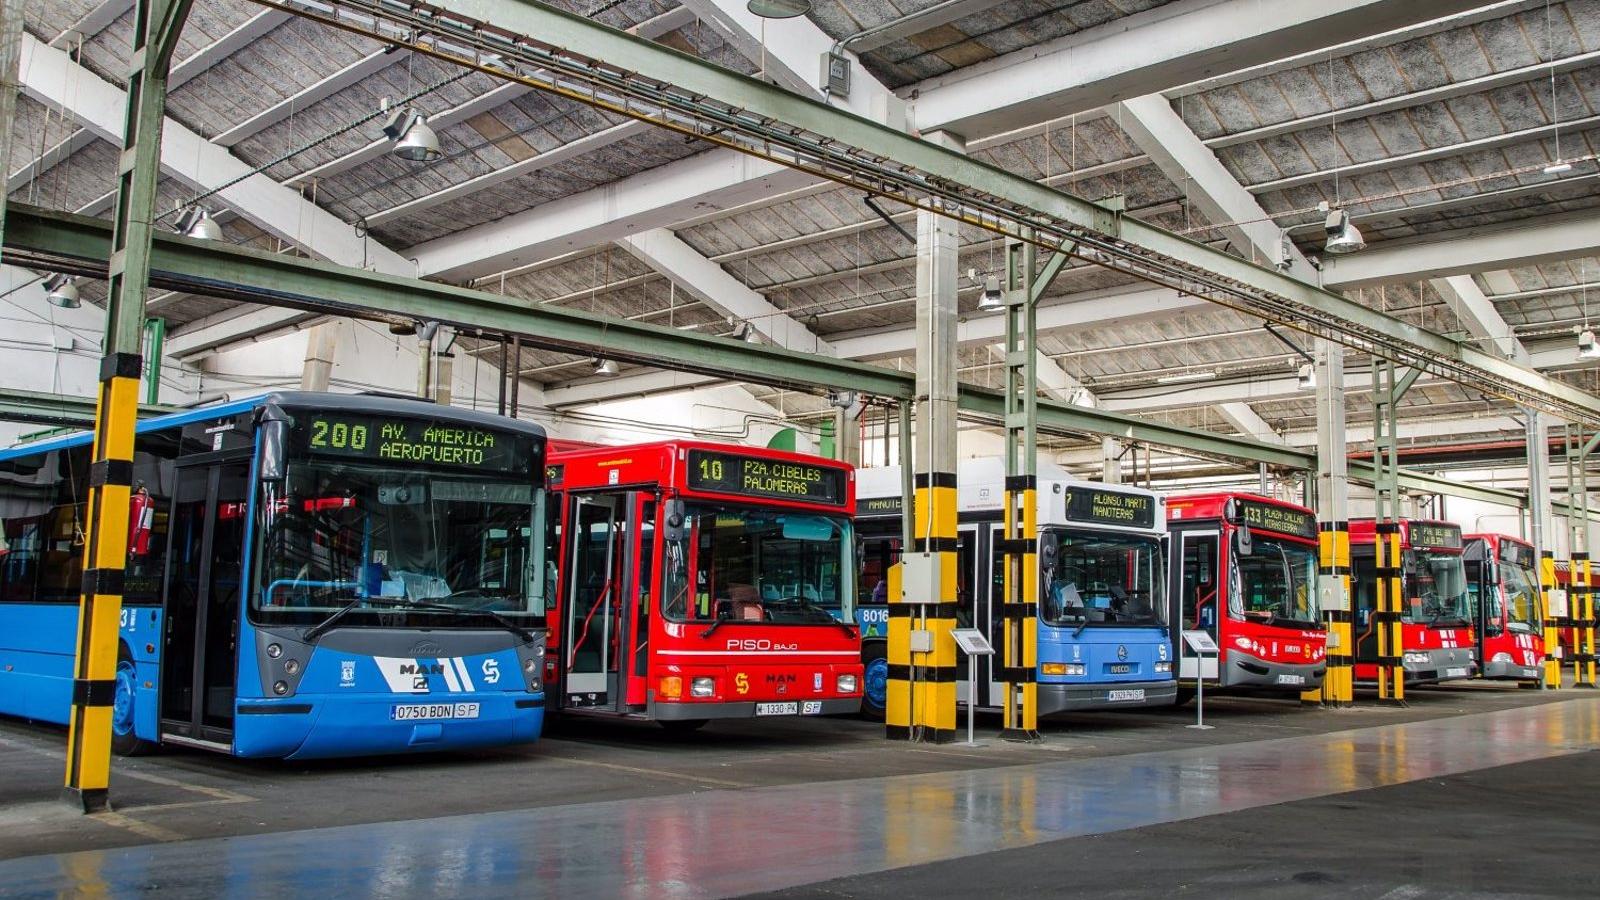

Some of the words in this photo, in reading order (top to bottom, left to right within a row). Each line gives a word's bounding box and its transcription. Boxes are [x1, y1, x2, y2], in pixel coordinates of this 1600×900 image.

[312, 421, 367, 450] 200
[381, 423, 407, 441] AV.
[424, 426, 495, 448] AMERICA
[380, 442, 483, 465] AEROPUERTO
[700, 460, 722, 480] 10
[744, 476, 808, 495] PALOMERAS
[1092, 506, 1134, 520] MANOTERAS
[1244, 506, 1261, 523] 133
[863, 610, 889, 623] 8016
[727, 639, 771, 650] PISO
[400, 664, 445, 675] MAN
[1111, 665, 1130, 673] IVECO
[766, 674, 796, 683] MAN
[398, 706, 427, 719] 0750
[430, 705, 451, 717] BDN
